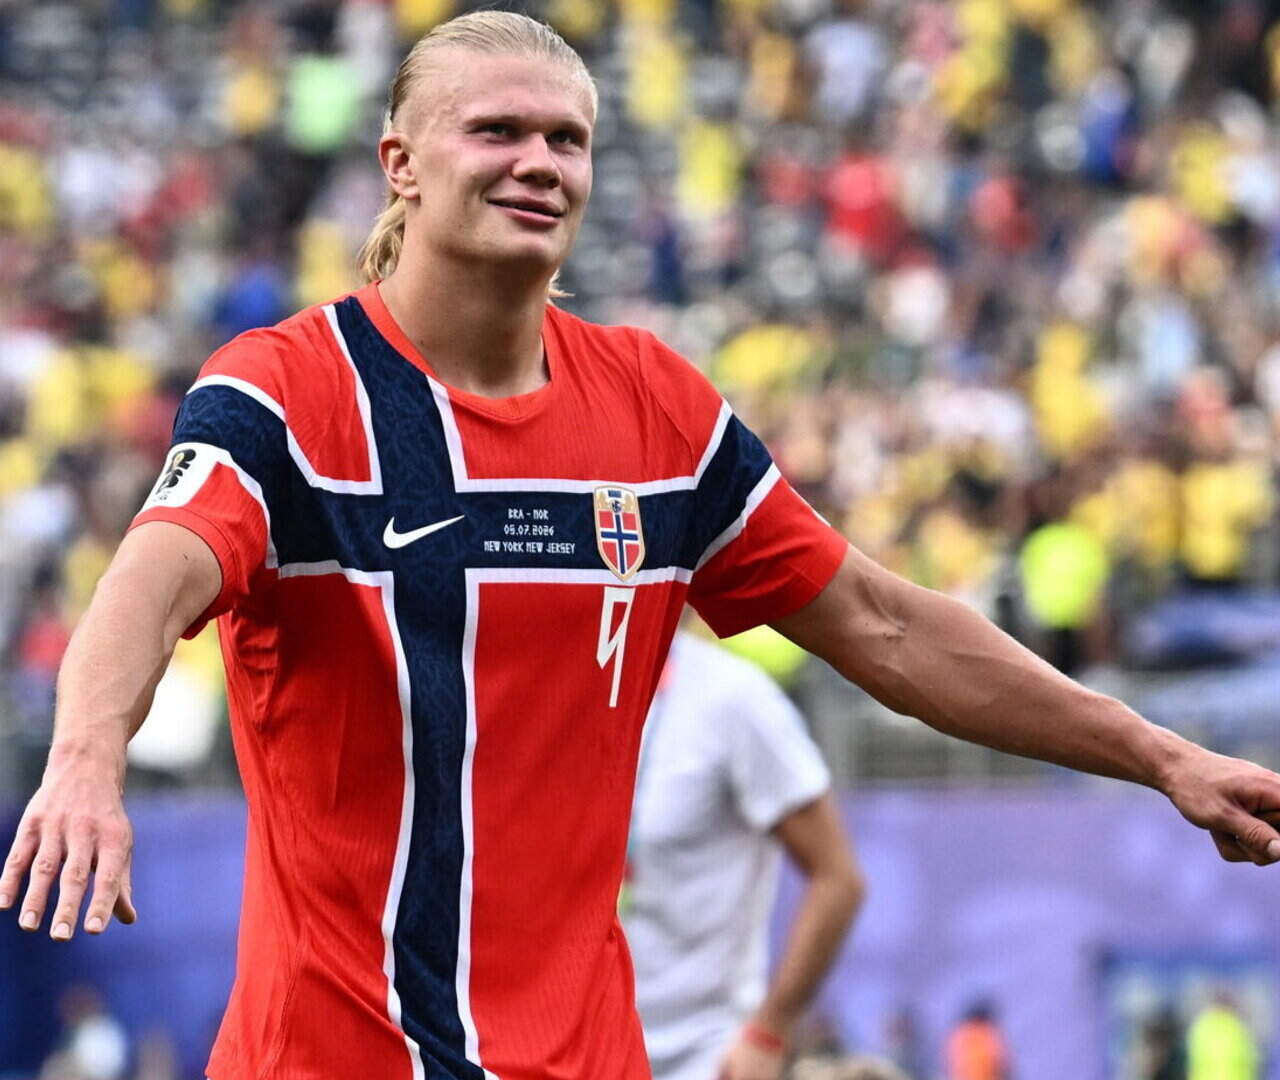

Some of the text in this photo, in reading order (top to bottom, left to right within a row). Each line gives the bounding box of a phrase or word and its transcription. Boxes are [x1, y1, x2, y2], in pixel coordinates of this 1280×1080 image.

[508, 508, 524, 520] BRA
[533, 509, 549, 520] NOR
[504, 524, 554, 536] 05.07.2026
[484, 541, 576, 554] NEW YORK NEW JERSEY
[596, 585, 636, 708] 9
